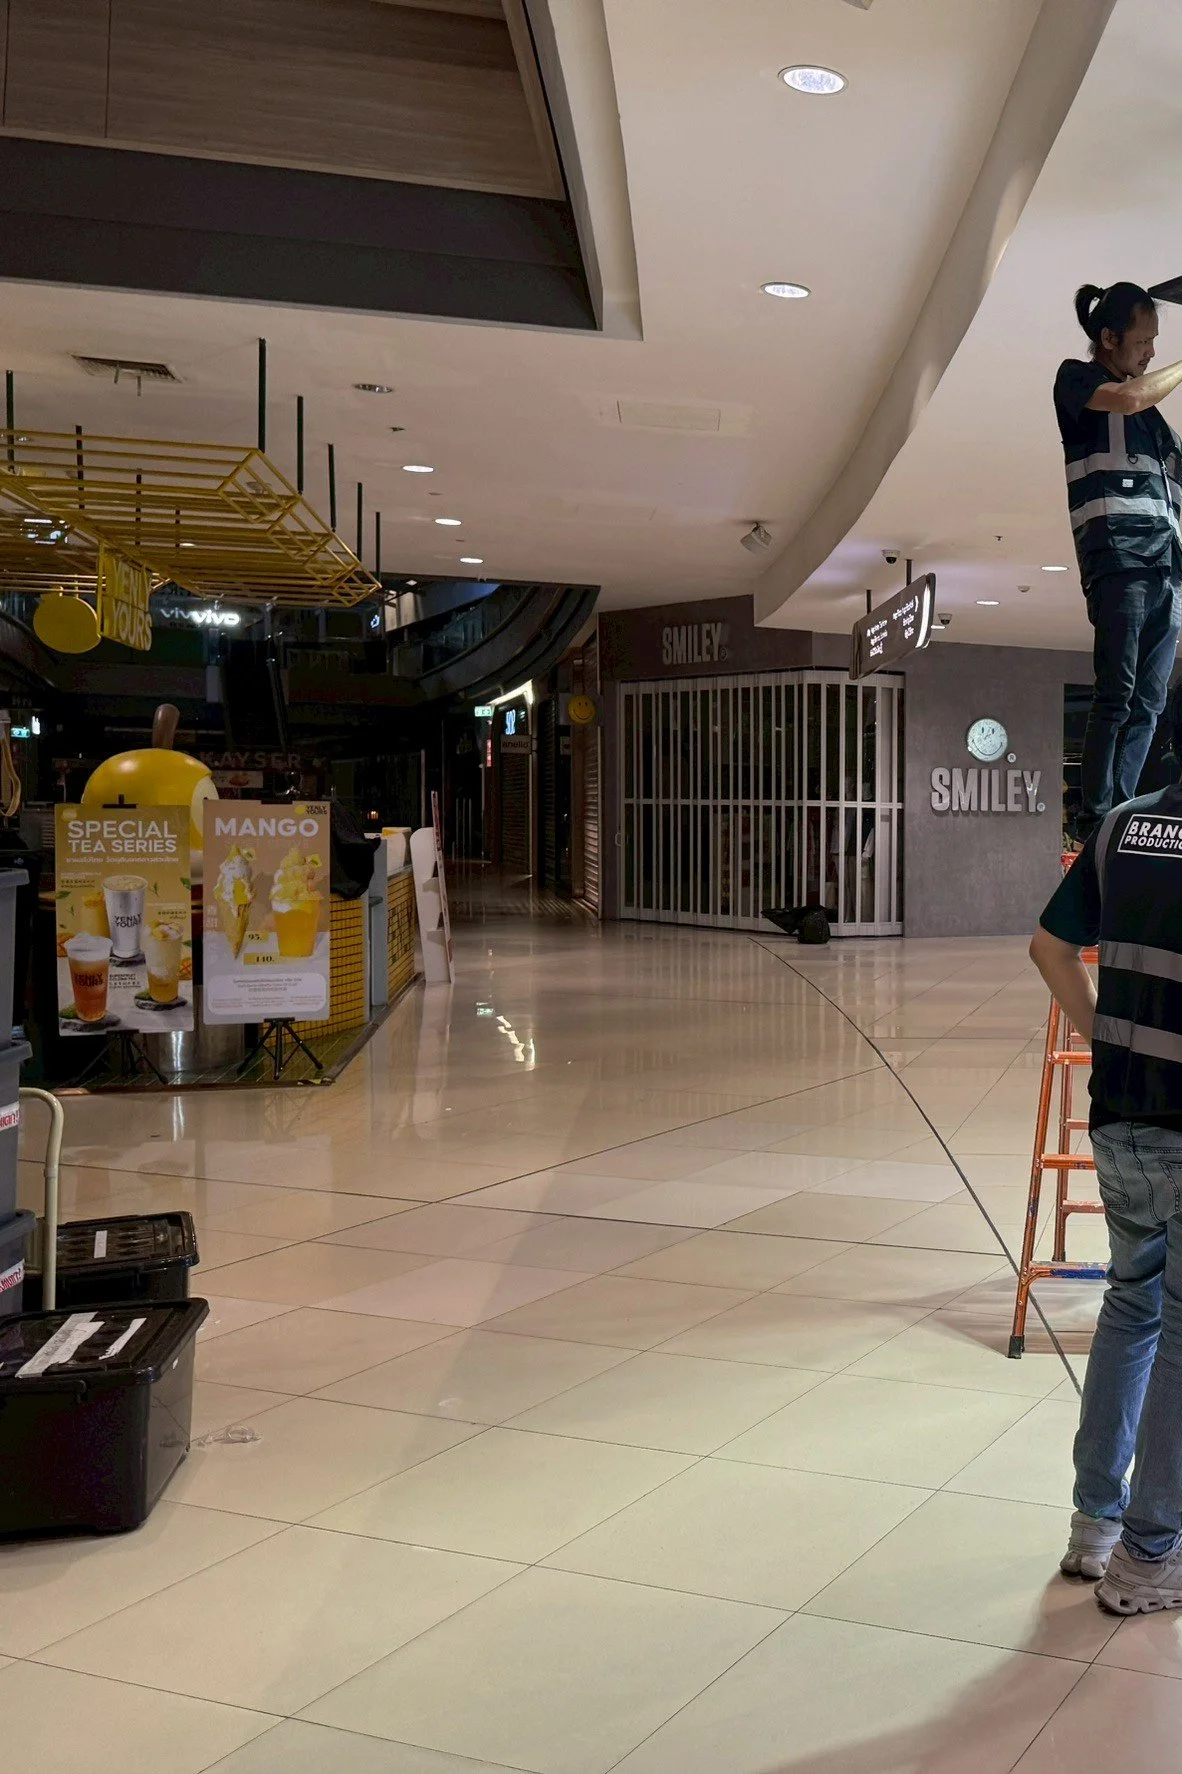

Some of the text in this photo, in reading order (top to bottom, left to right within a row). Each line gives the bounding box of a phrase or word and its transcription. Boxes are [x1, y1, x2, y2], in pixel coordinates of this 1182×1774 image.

[112, 599, 152, 651] YOURS
[191, 609, 240, 625] vivo
[68, 820, 177, 838] SPECIAL
[215, 817, 319, 837] MANGO
[68, 839, 177, 853] TEA SERIES
